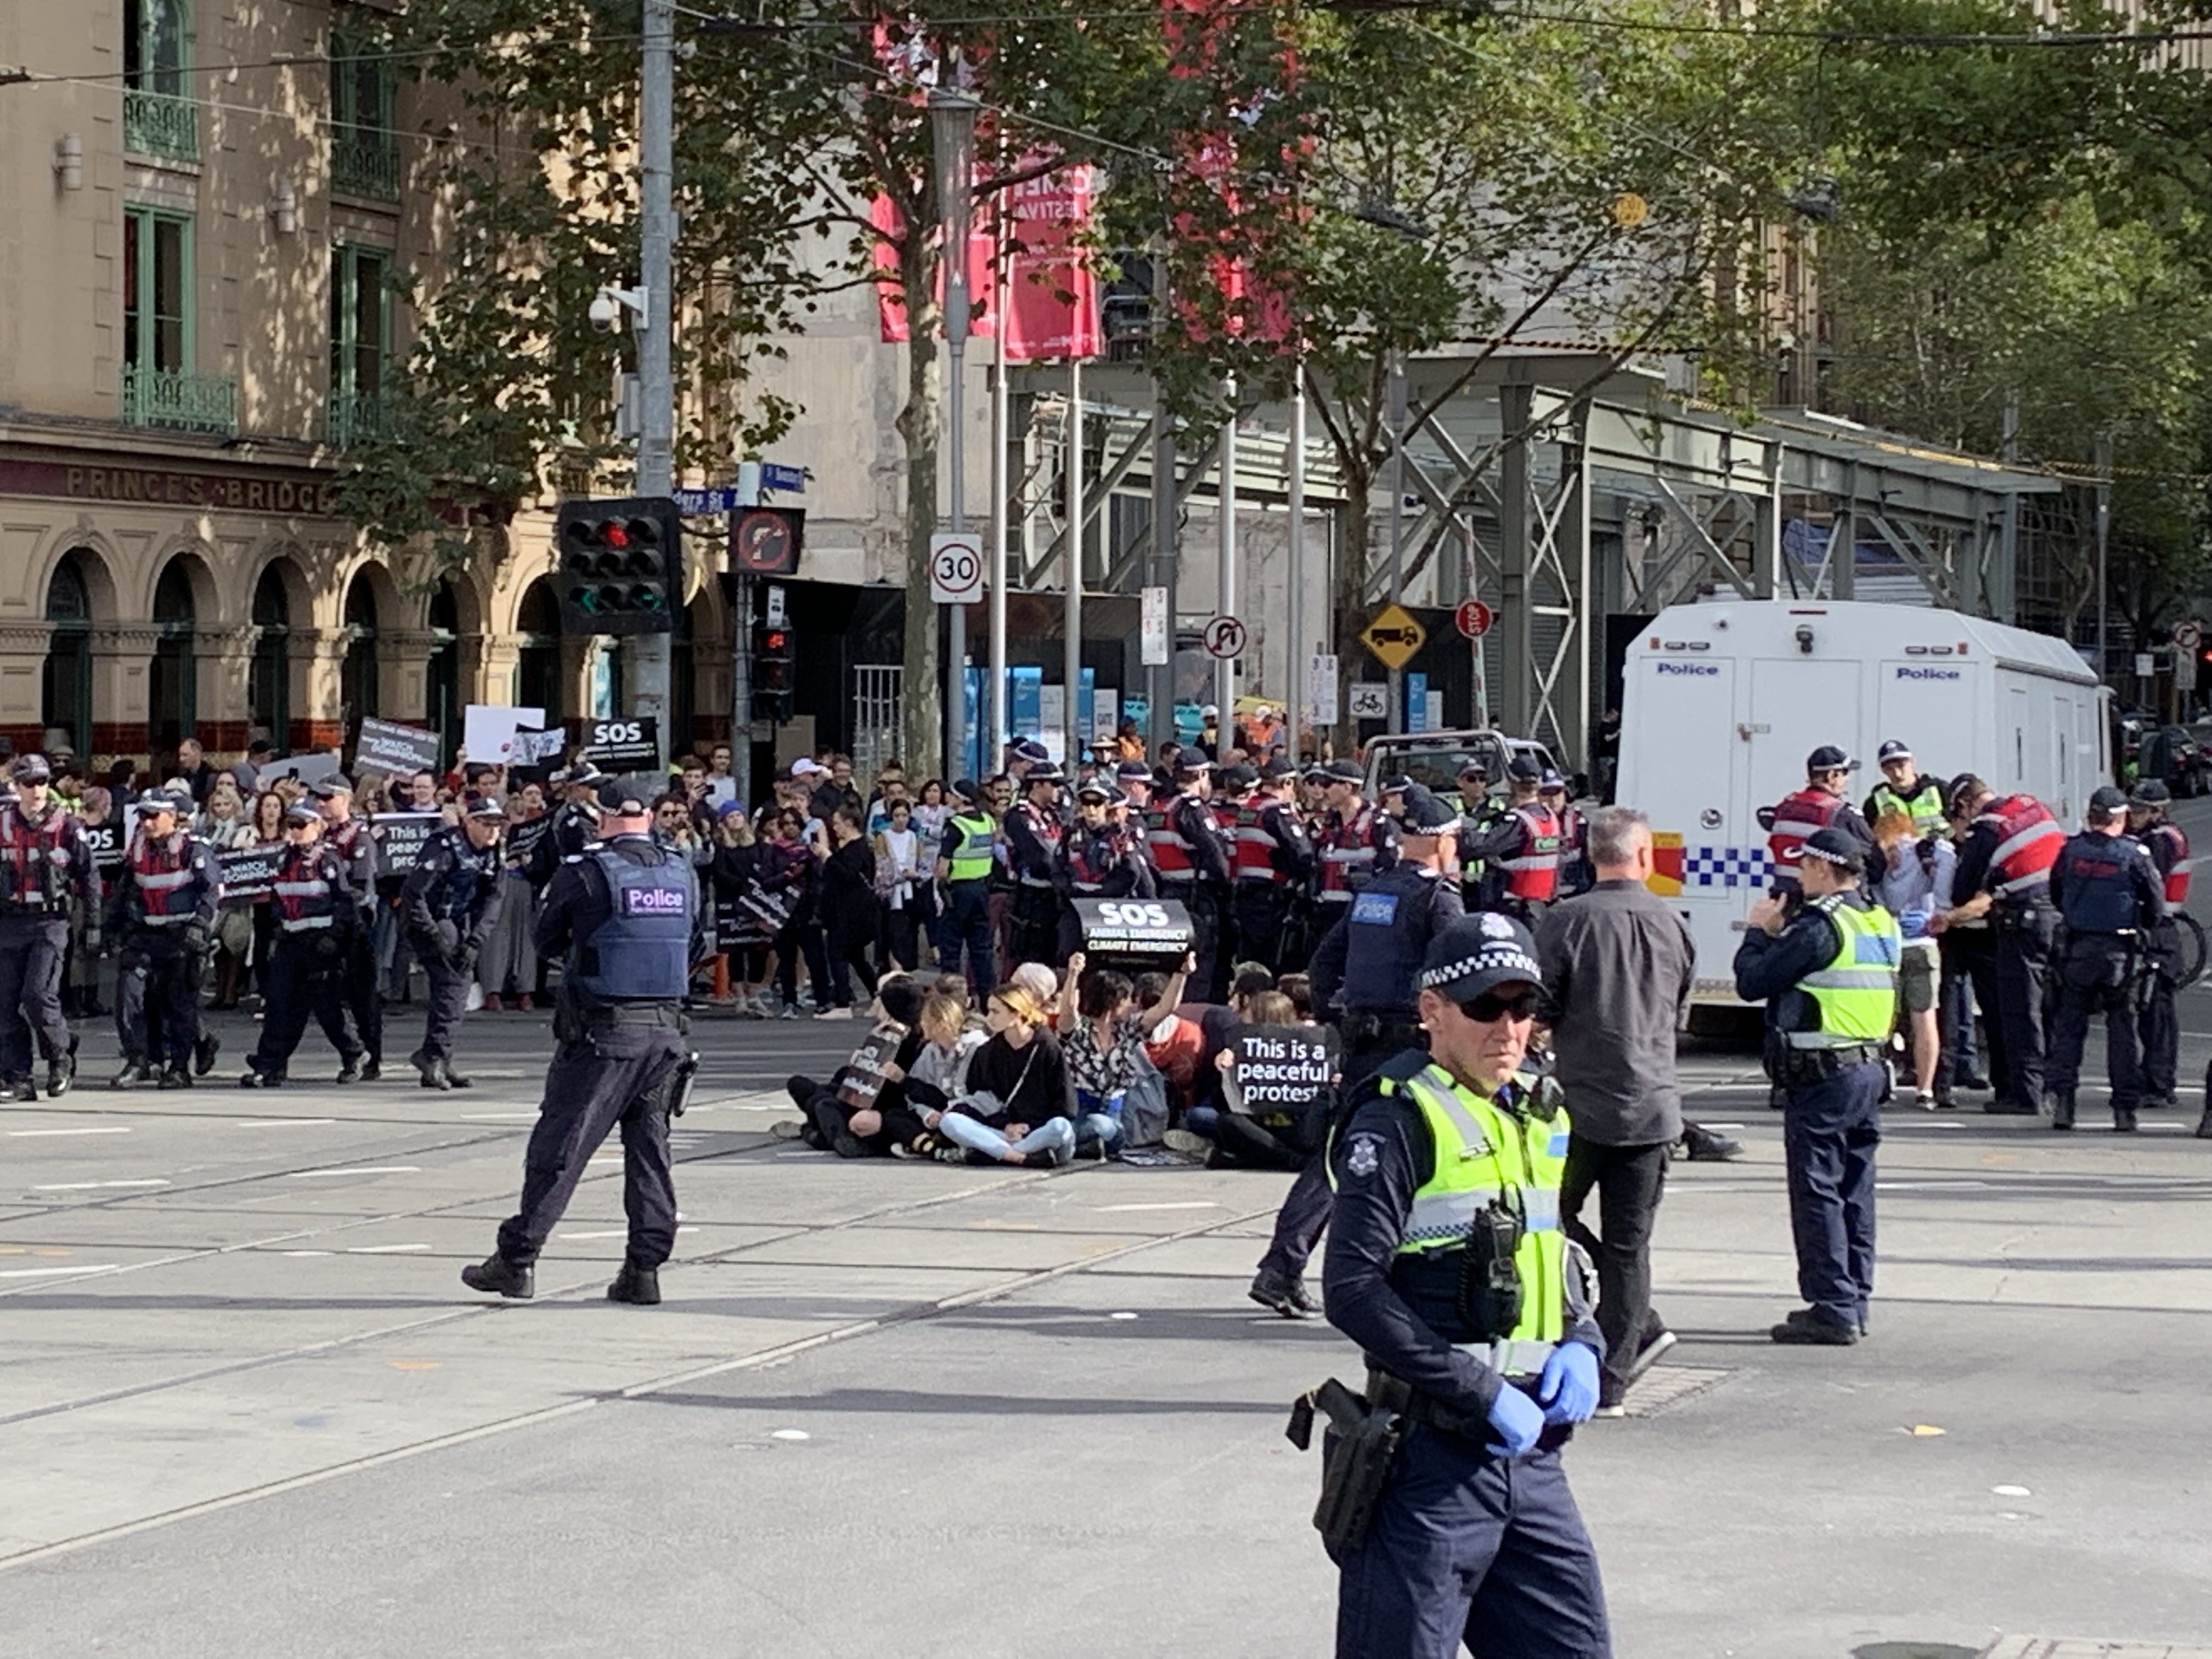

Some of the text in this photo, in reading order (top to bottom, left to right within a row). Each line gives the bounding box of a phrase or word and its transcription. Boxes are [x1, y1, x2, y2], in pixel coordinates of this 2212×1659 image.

[67, 467, 204, 504] PRINCE'S
[940, 556, 974, 580] 30
[1467, 604, 1482, 634] STOP
[1657, 662, 1718, 675] Police
[1897, 667, 1960, 680] Police
[594, 722, 642, 744] SOS
[87, 829, 114, 850] OS
[388, 826, 417, 839] This
[629, 889, 684, 907] Police
[1098, 902, 1169, 927] SOS
[1243, 1037, 1325, 1061] This is a
[1238, 1060, 1329, 1083] peaceful
[1244, 1084, 1318, 1105] protest
